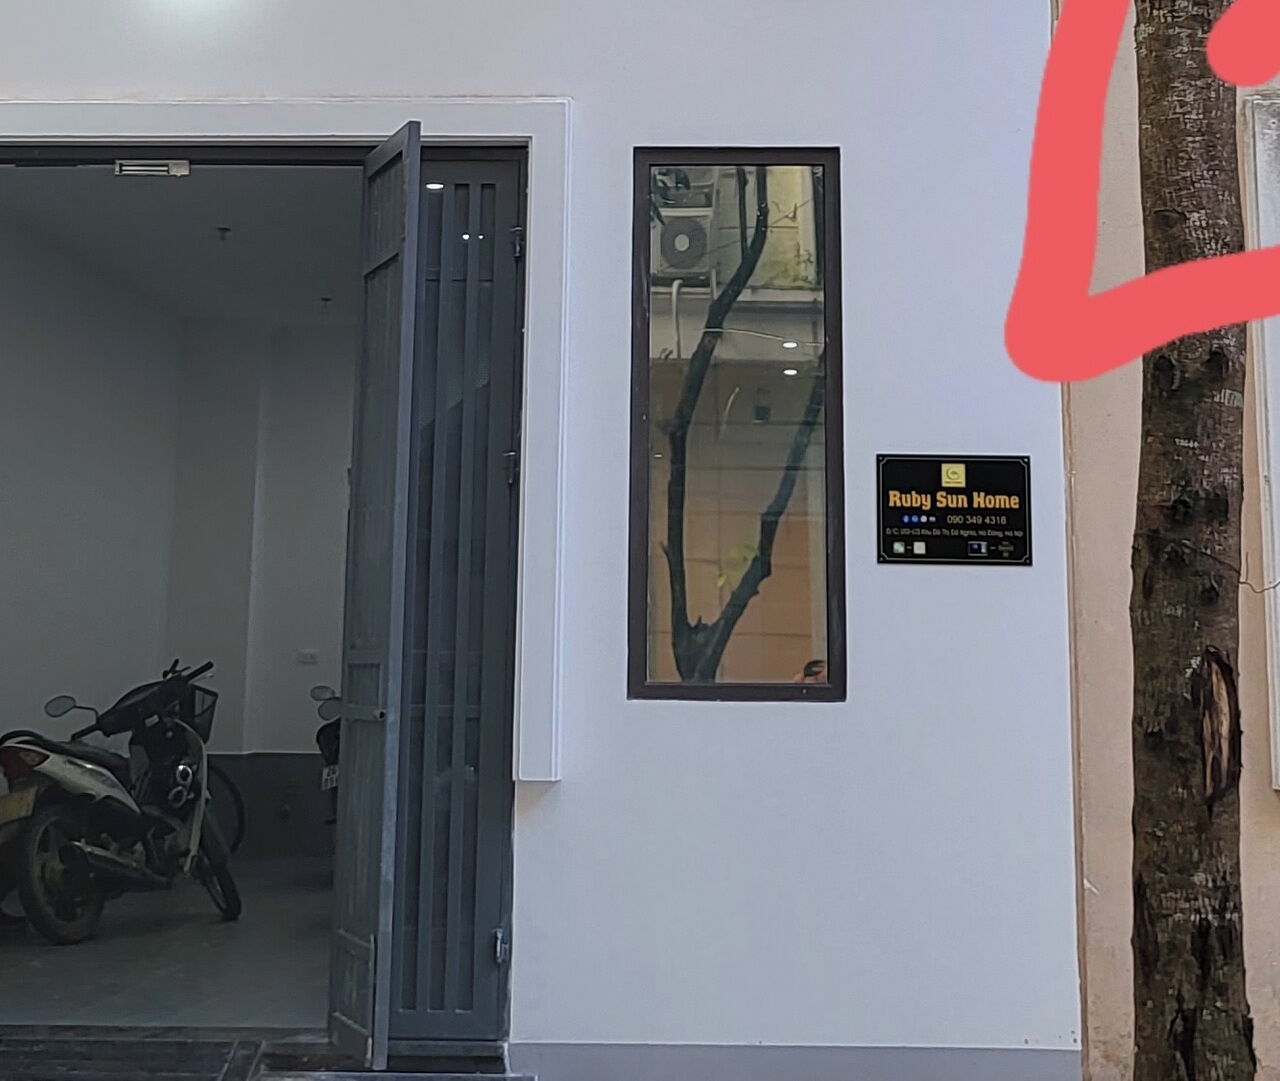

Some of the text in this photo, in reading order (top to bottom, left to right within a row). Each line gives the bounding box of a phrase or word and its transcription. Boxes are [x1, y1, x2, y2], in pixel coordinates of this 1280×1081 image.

[888, 490, 1020, 510] Ruby Sun Home
[947, 515, 964, 525] 090
[965, 515, 983, 525] 349
